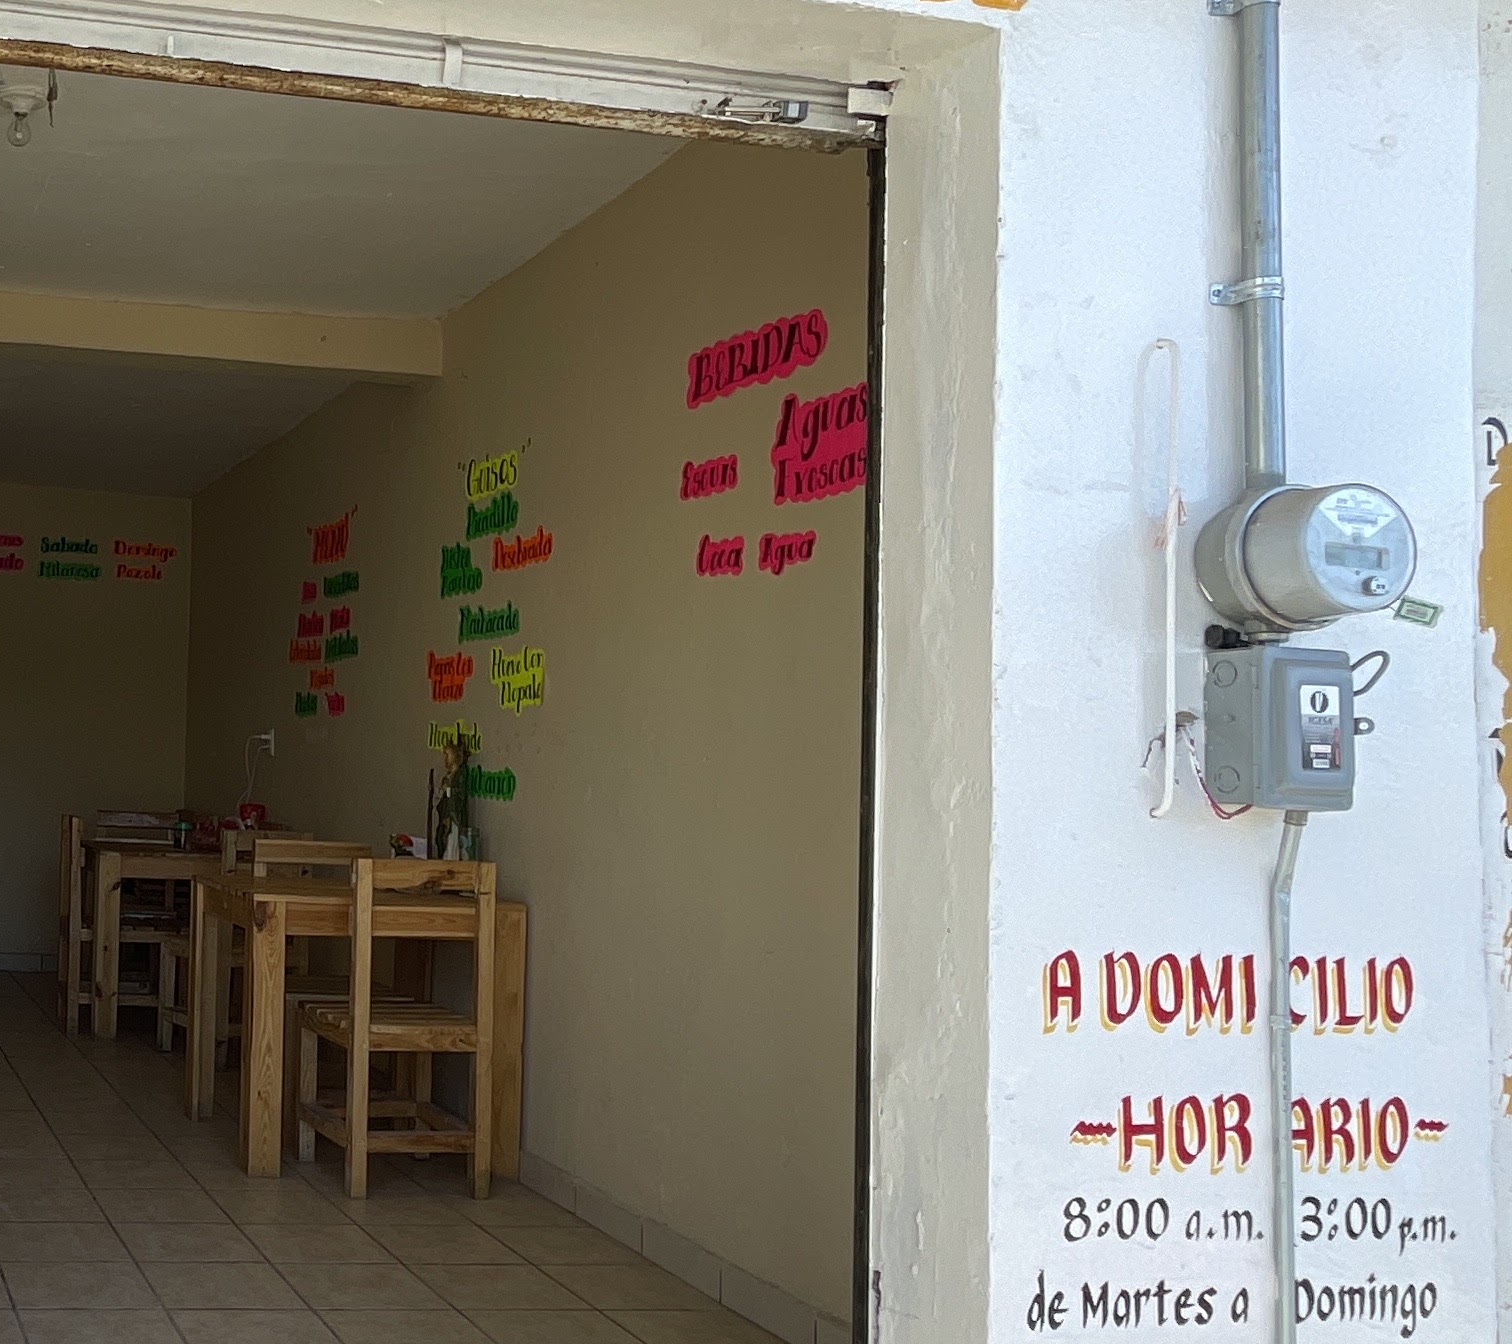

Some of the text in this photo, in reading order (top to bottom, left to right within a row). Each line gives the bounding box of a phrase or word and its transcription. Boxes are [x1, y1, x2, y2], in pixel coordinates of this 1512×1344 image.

[776, 383, 868, 462] Aguas
[1042, 949, 1082, 1035] A
[1063, 1196, 1457, 1256] 8:00 a.m. 3:00 p.m.
[1026, 1269, 1437, 1340] de Martes a Domingo
